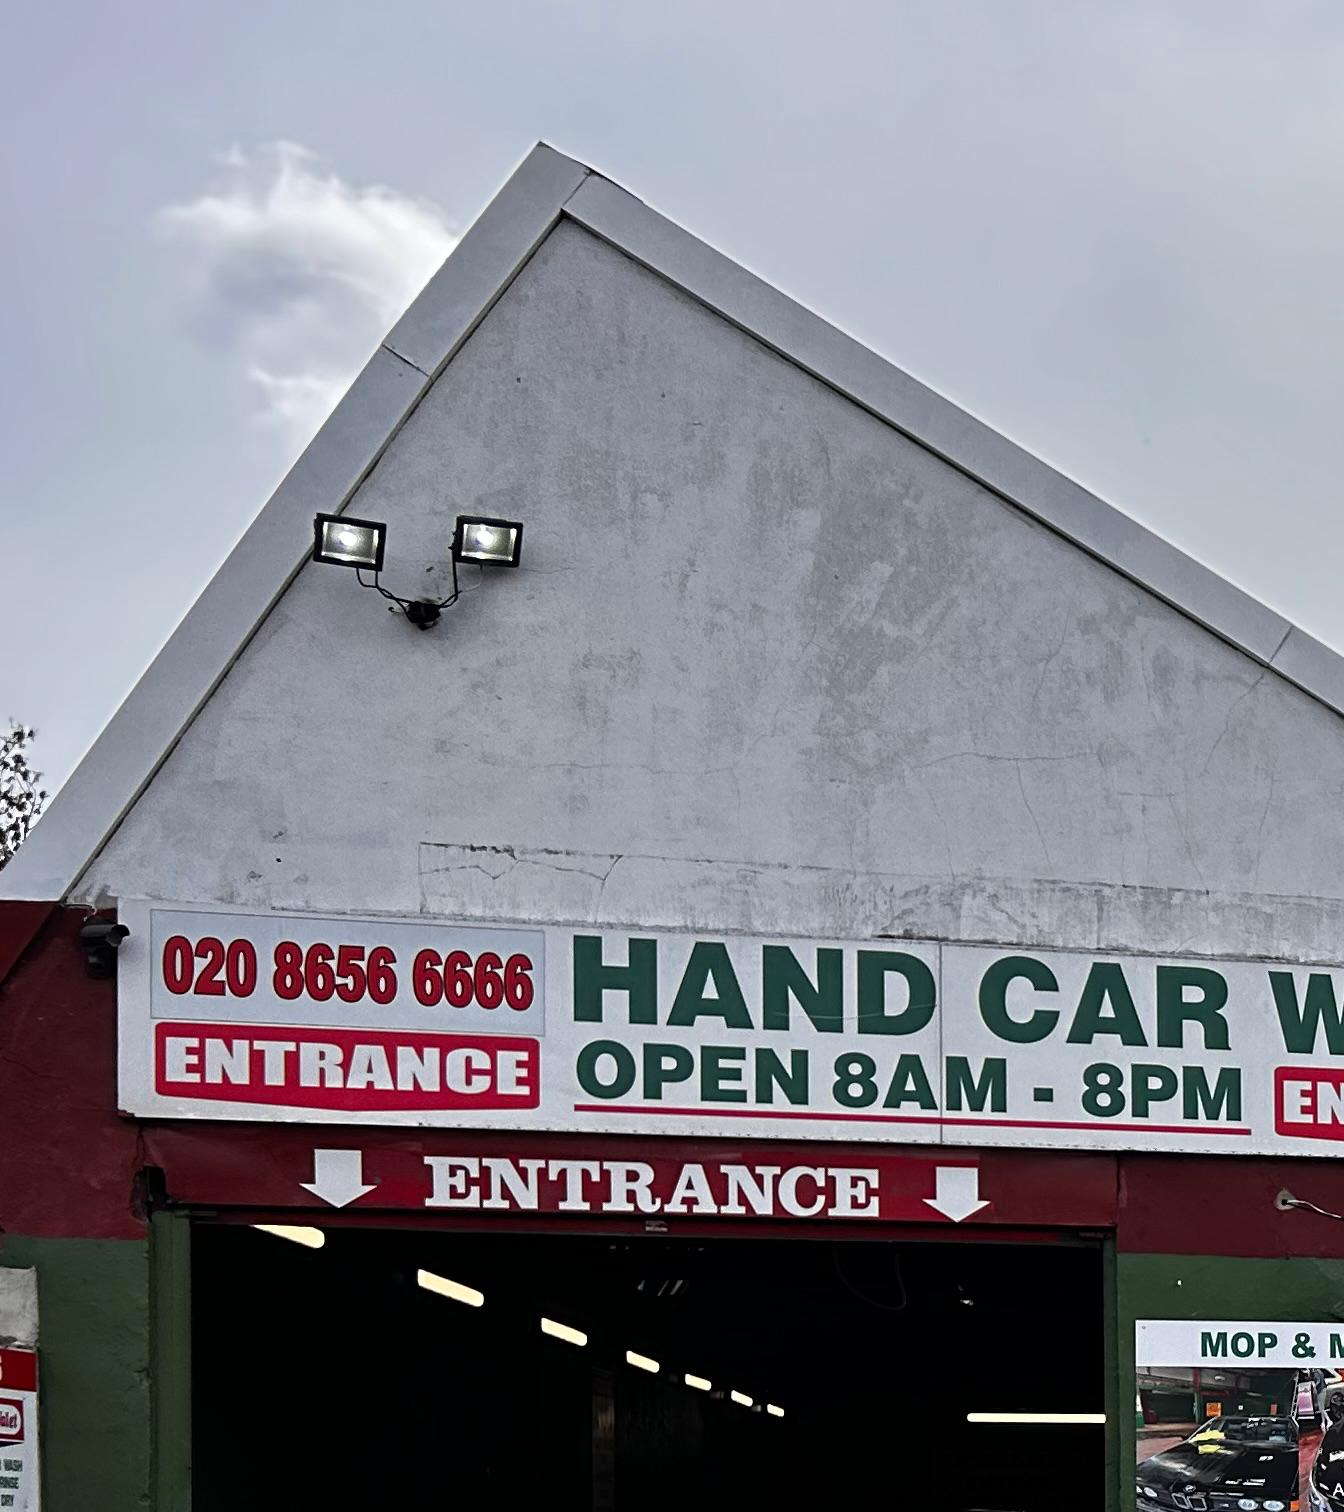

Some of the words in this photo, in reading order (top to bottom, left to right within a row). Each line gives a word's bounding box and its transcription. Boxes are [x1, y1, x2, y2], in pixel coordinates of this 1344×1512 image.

[162, 935, 257, 998] 020
[273, 942, 398, 1004] 8656
[412, 948, 535, 1011] 6666
[572, 935, 937, 1035] HAND
[978, 956, 1232, 1051] CAR
[163, 1035, 532, 1097] ENTRANCE
[575, 1038, 810, 1106] OPEN
[832, 1051, 1008, 1114] 8AM
[1081, 1062, 1243, 1123] 8PM
[423, 1154, 881, 1219] ENTRANCE
[1200, 1331, 1280, 1359] MOP
[1291, 1333, 1317, 1359] &
